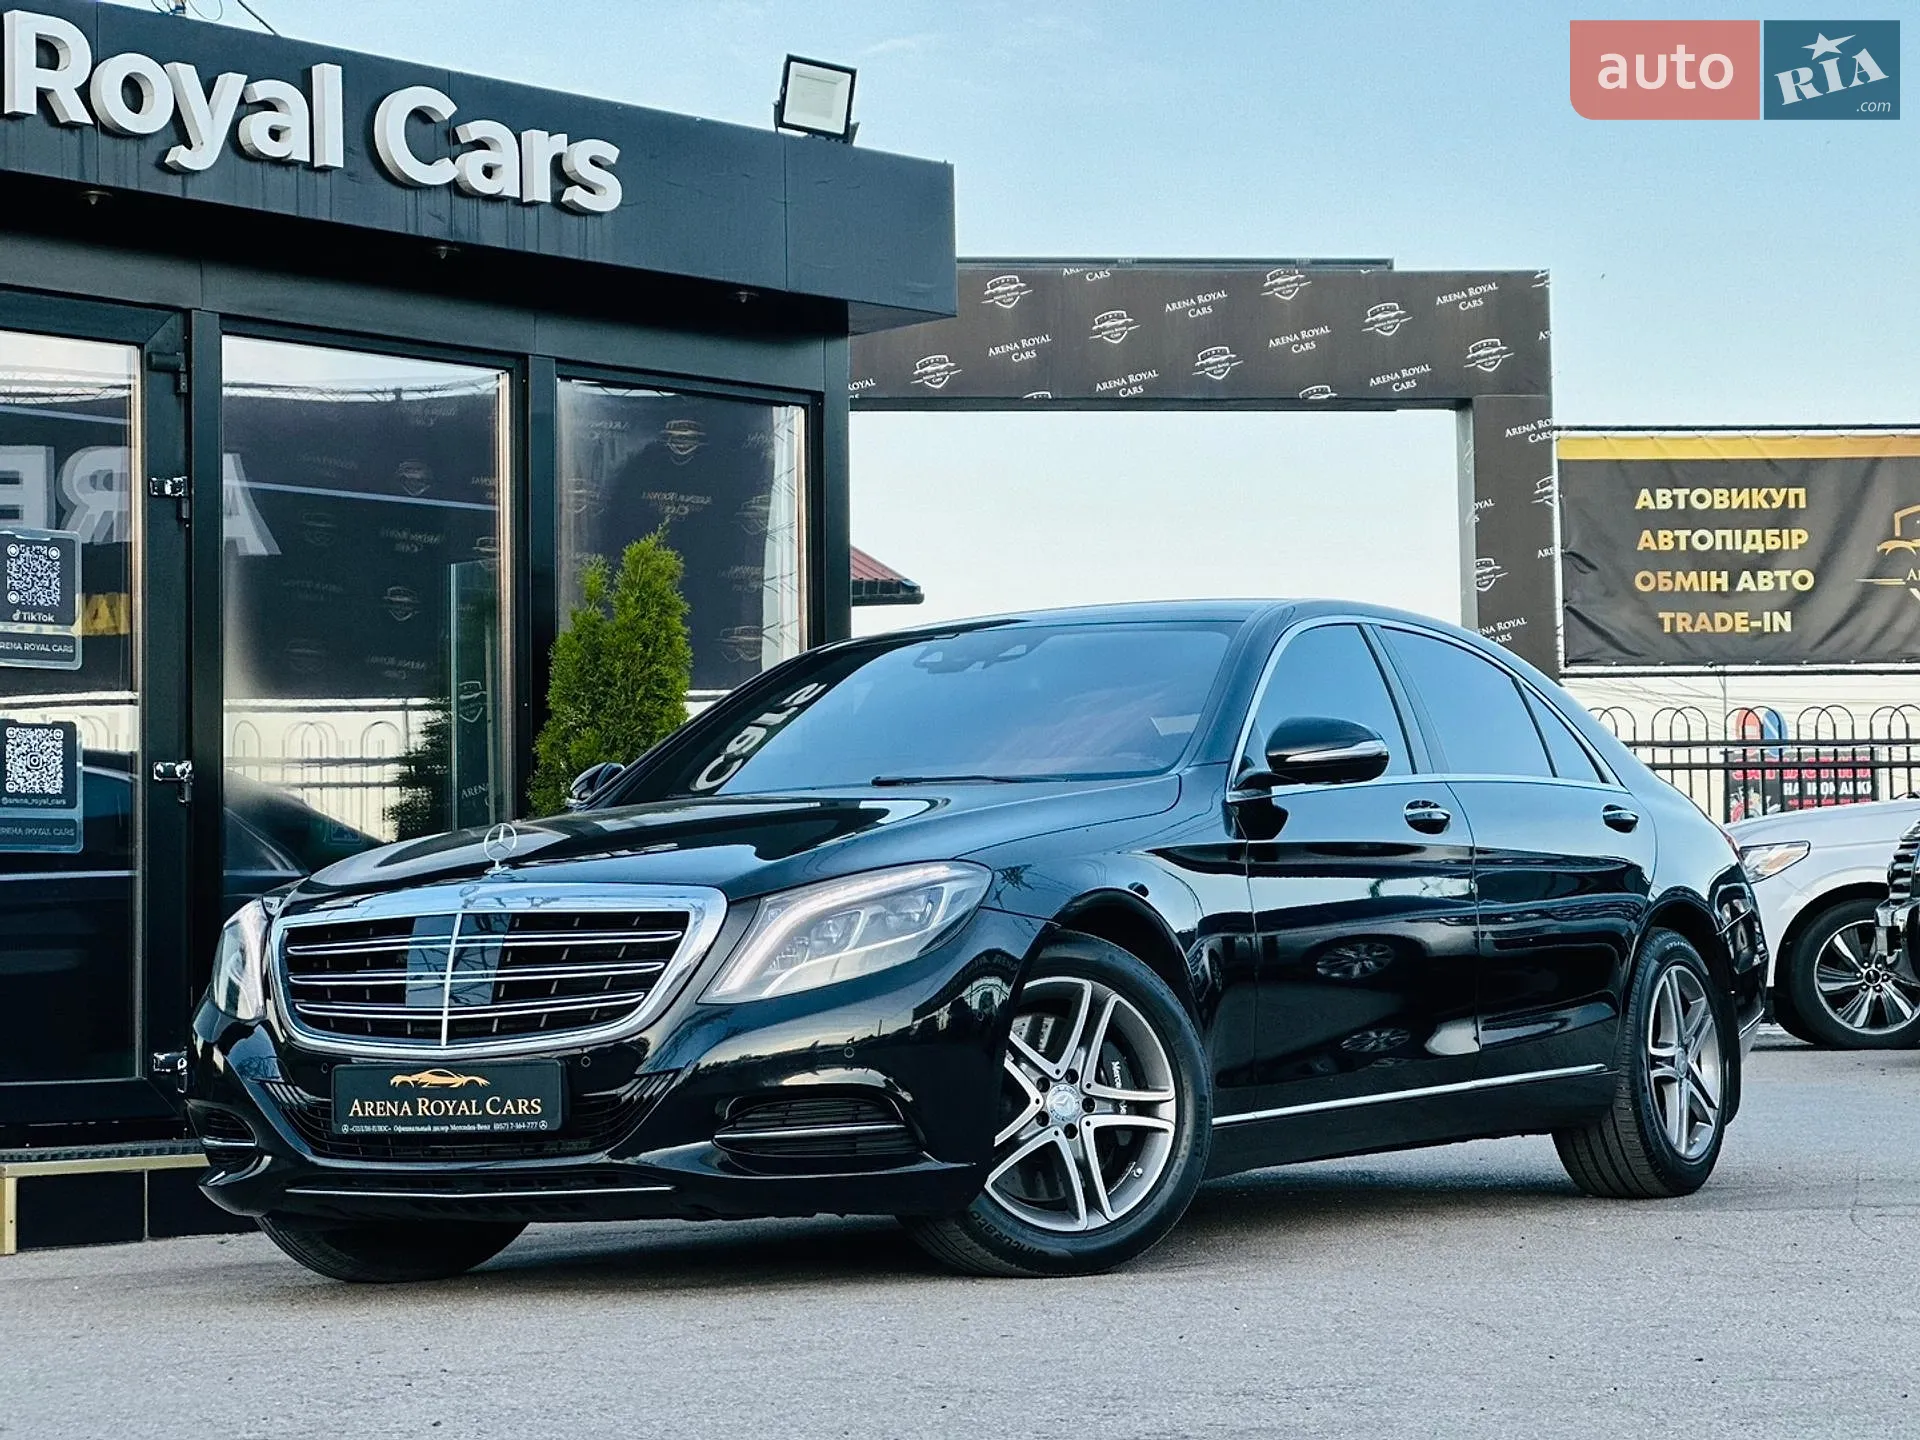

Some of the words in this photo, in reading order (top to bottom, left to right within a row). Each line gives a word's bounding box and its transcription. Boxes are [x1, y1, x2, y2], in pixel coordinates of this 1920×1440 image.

[3, 9, 344, 172] Royal
[374, 84, 623, 214] Cars
[1165, 298, 1195, 313] ARENA
[1197, 289, 1228, 304] ROYAL
[1435, 290, 1468, 305] ARENA
[1468, 281, 1499, 297] ROYAL
[1458, 297, 1484, 311] CARS
[1188, 305, 1213, 318] CARS
[987, 342, 1020, 357] ARENA
[1021, 333, 1052, 349] ROYAL
[1268, 333, 1300, 348] ARENA
[1300, 325, 1331, 341] ROYAL
[1291, 341, 1316, 354] CARS
[1011, 349, 1037, 363] CARS
[1095, 378, 1127, 392] ARENA
[1128, 369, 1159, 384] ROYAL
[1369, 371, 1400, 387] ARENA
[1401, 363, 1432, 378] ROYAL
[1391, 379, 1417, 393] CARS
[1119, 385, 1144, 398] CARS
[1505, 423, 1537, 438] ARENA
[1634, 487, 1807, 510] АВТОВИКУП
[1636, 528, 1809, 554] АВТОПІДБІР
[1634, 570, 1729, 593] ОБМІН
[1735, 568, 1815, 592] АВТО
[21, 611, 55, 623] TikTok
[1496, 617, 1528, 631] ROYAL
[1657, 610, 1793, 633] TRADE-IN
[23, 642, 51, 652] ROYAL
[348, 1097, 413, 1117] ARENA
[416, 1097, 483, 1116] ROYAL
[485, 1096, 542, 1116] CARS
